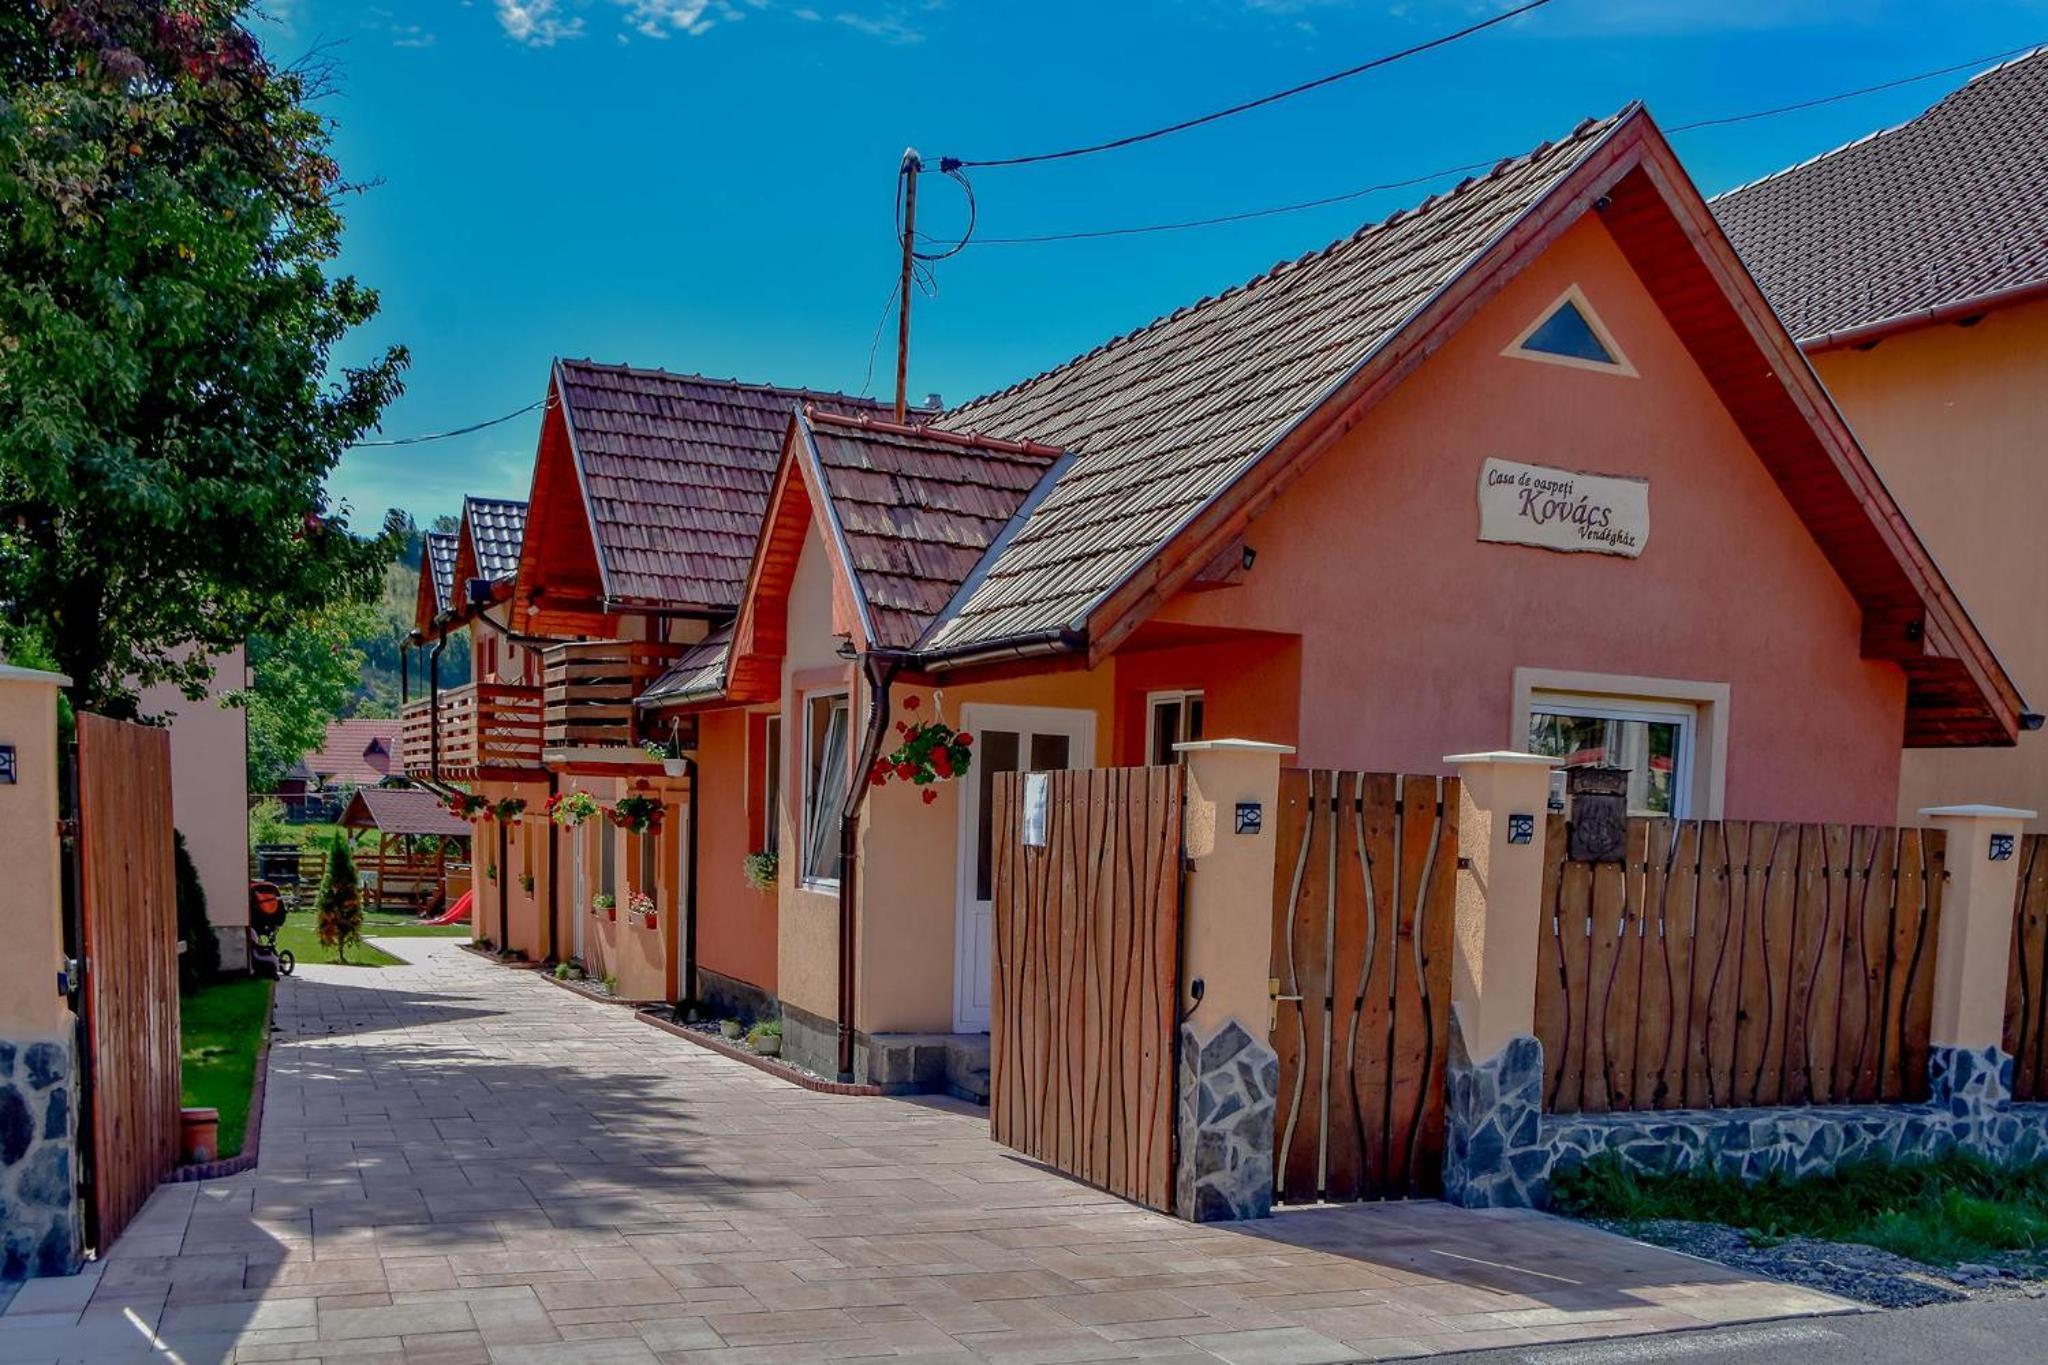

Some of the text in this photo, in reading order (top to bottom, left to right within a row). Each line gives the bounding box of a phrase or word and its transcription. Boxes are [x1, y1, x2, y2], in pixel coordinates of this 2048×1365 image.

[1488, 469, 1515, 486] Casa
[1518, 472, 1531, 486] de
[1518, 488, 1612, 527] Kovács
[1578, 525, 1635, 547] Vendégház
